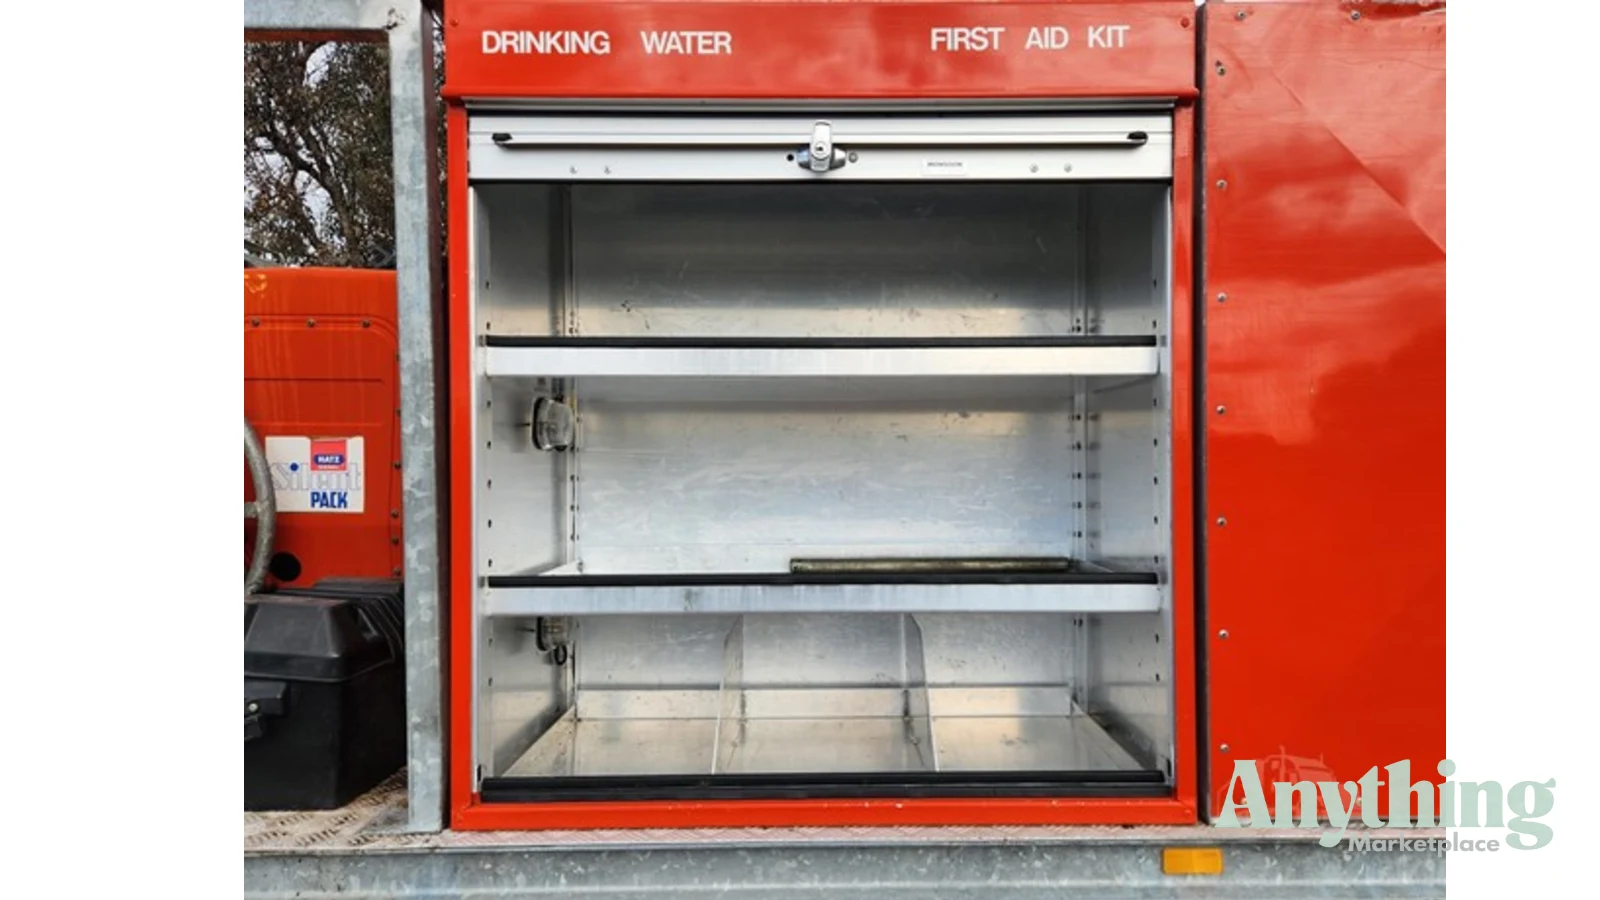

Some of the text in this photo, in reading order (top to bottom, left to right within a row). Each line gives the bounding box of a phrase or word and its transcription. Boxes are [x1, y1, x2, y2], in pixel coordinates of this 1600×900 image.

[481, 31, 733, 55] DRINKING WATER
[931, 25, 1130, 51] FIRST AID KIT
[310, 491, 348, 508] PACK
